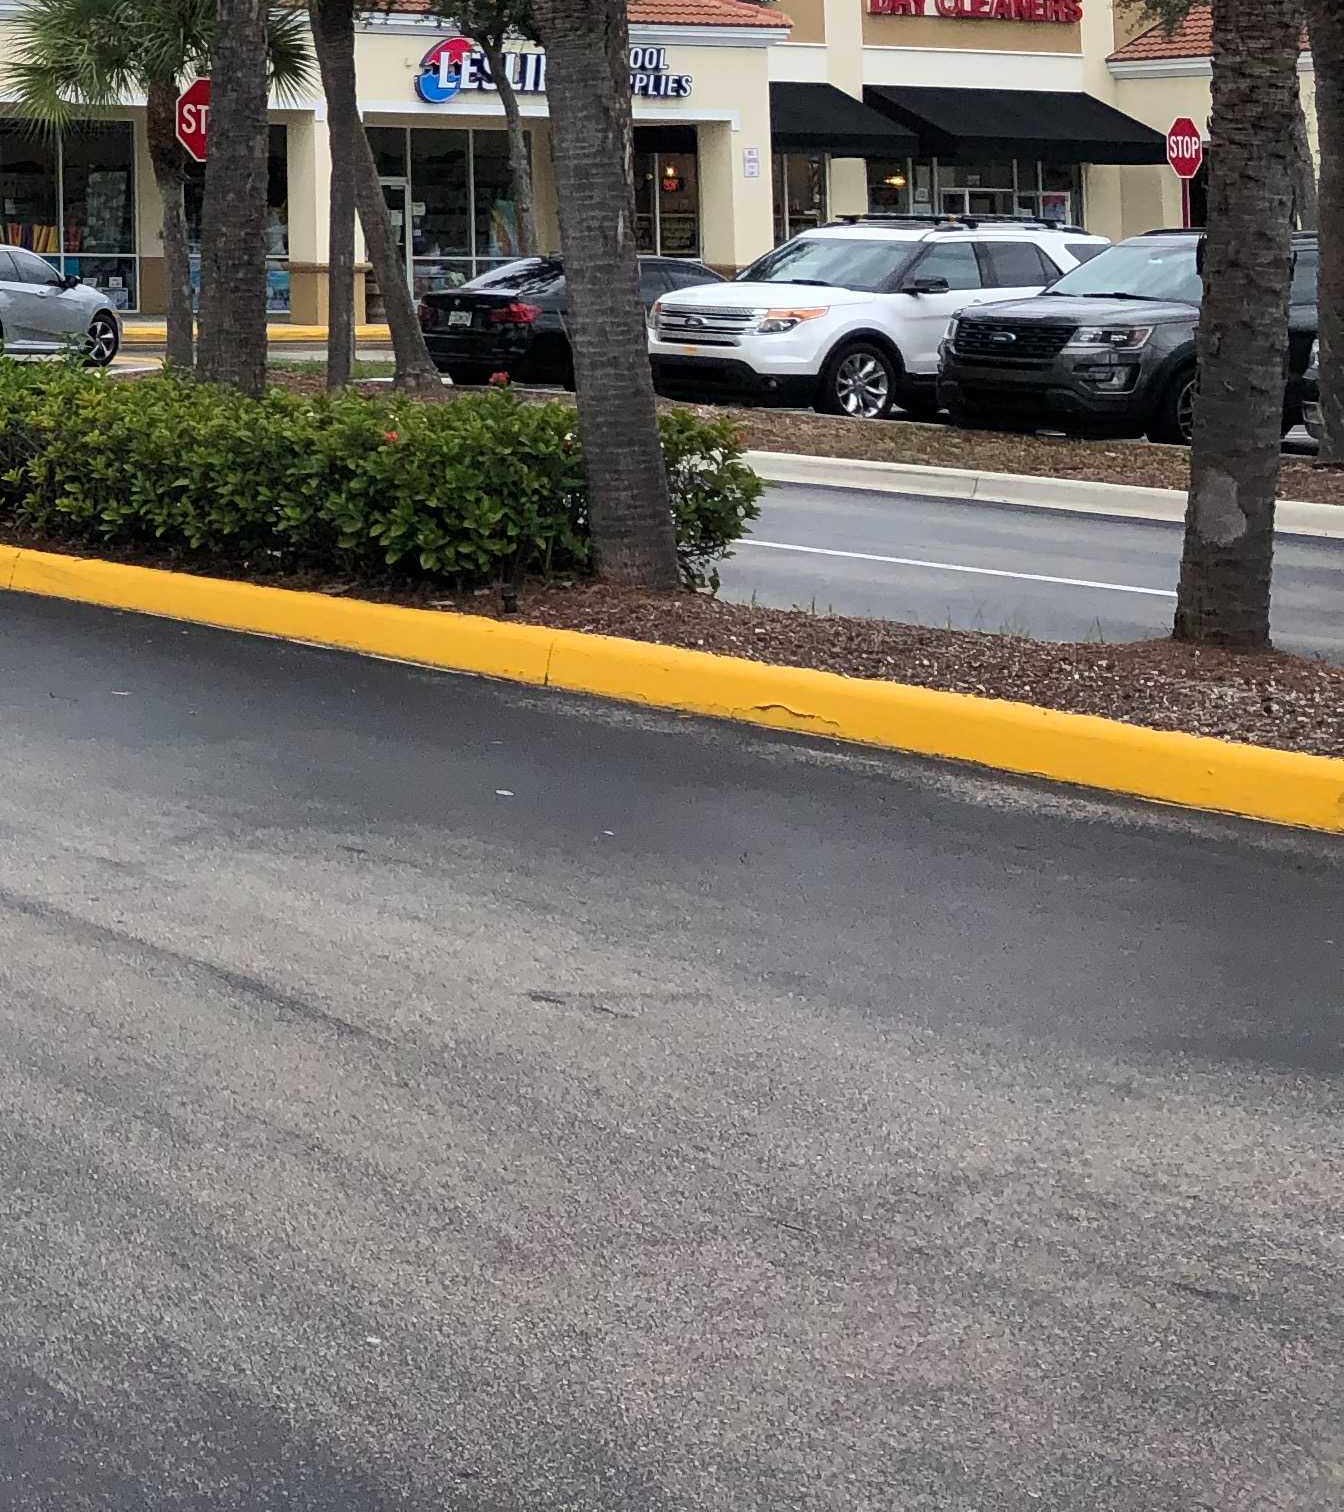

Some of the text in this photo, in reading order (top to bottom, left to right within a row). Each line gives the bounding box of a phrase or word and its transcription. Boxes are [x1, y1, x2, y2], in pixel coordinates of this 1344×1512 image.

[628, 47, 668, 69] OOL
[181, 103, 210, 135] ST
[1169, 135, 1200, 159] STOP
